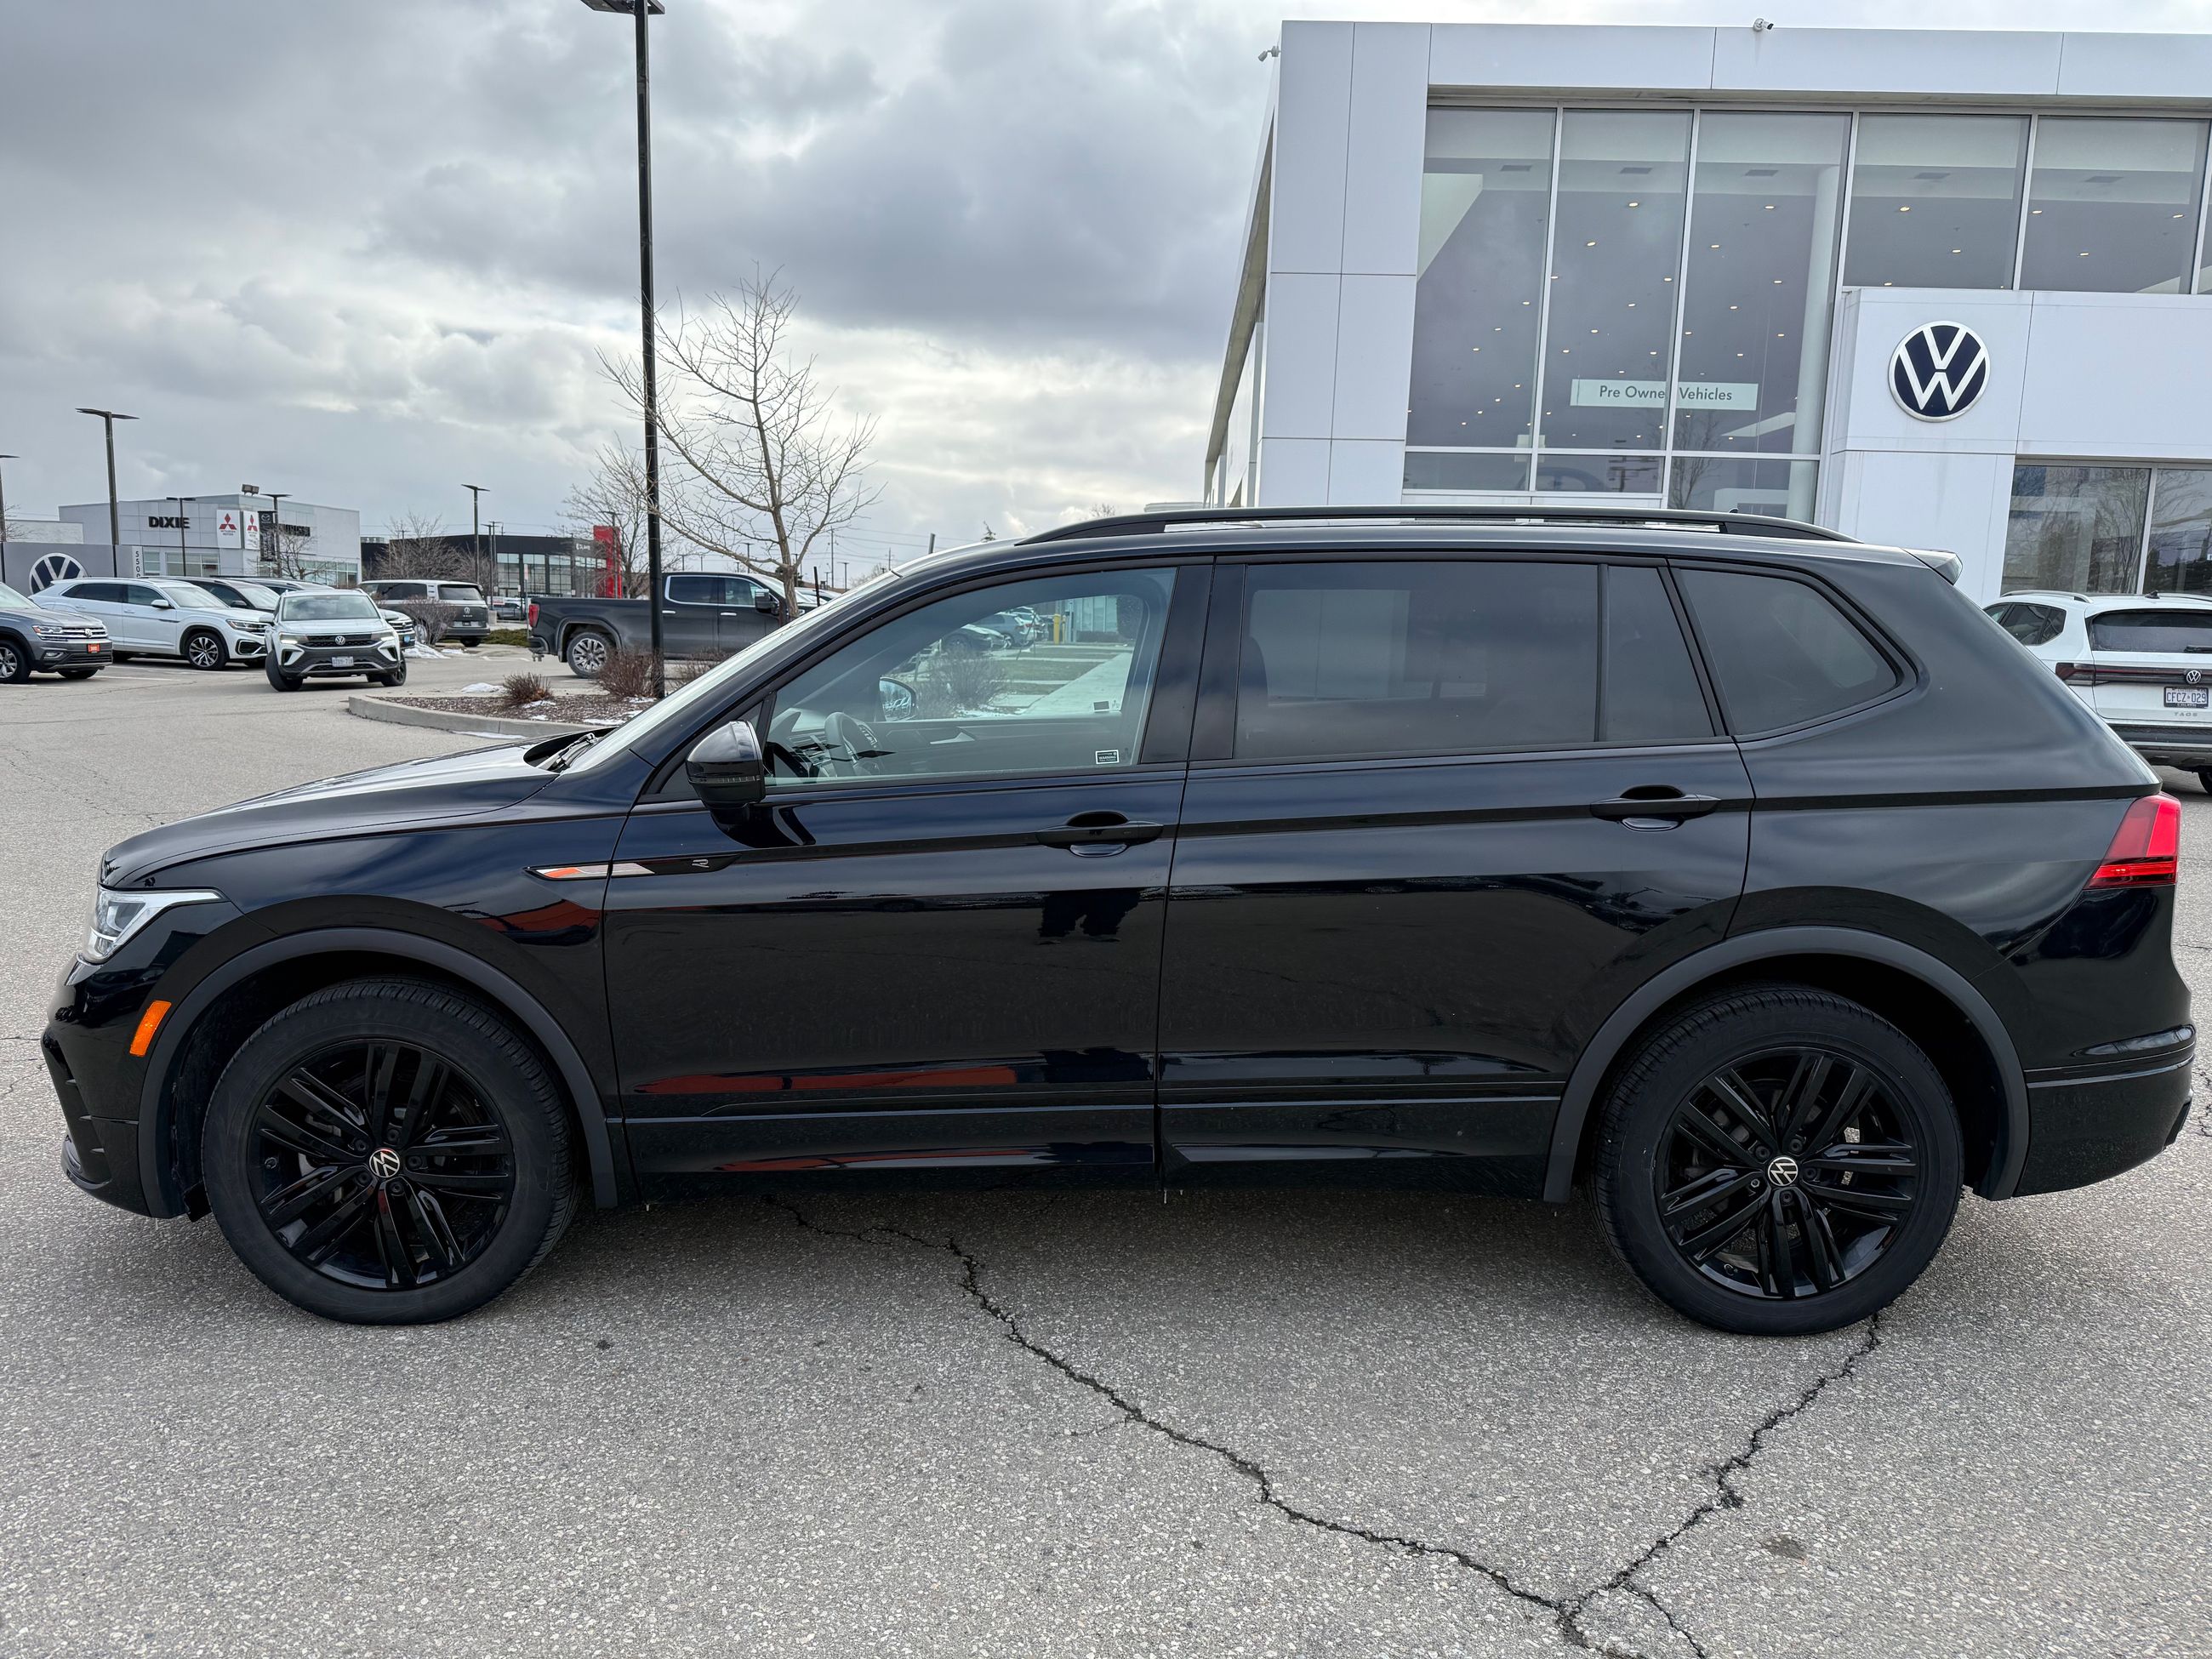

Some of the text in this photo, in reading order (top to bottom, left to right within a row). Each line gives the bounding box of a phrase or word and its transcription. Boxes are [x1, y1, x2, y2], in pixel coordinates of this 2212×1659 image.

[1599, 385, 1732, 401] Pre Owne Vehicles
[148, 516, 191, 528] DIXIE
